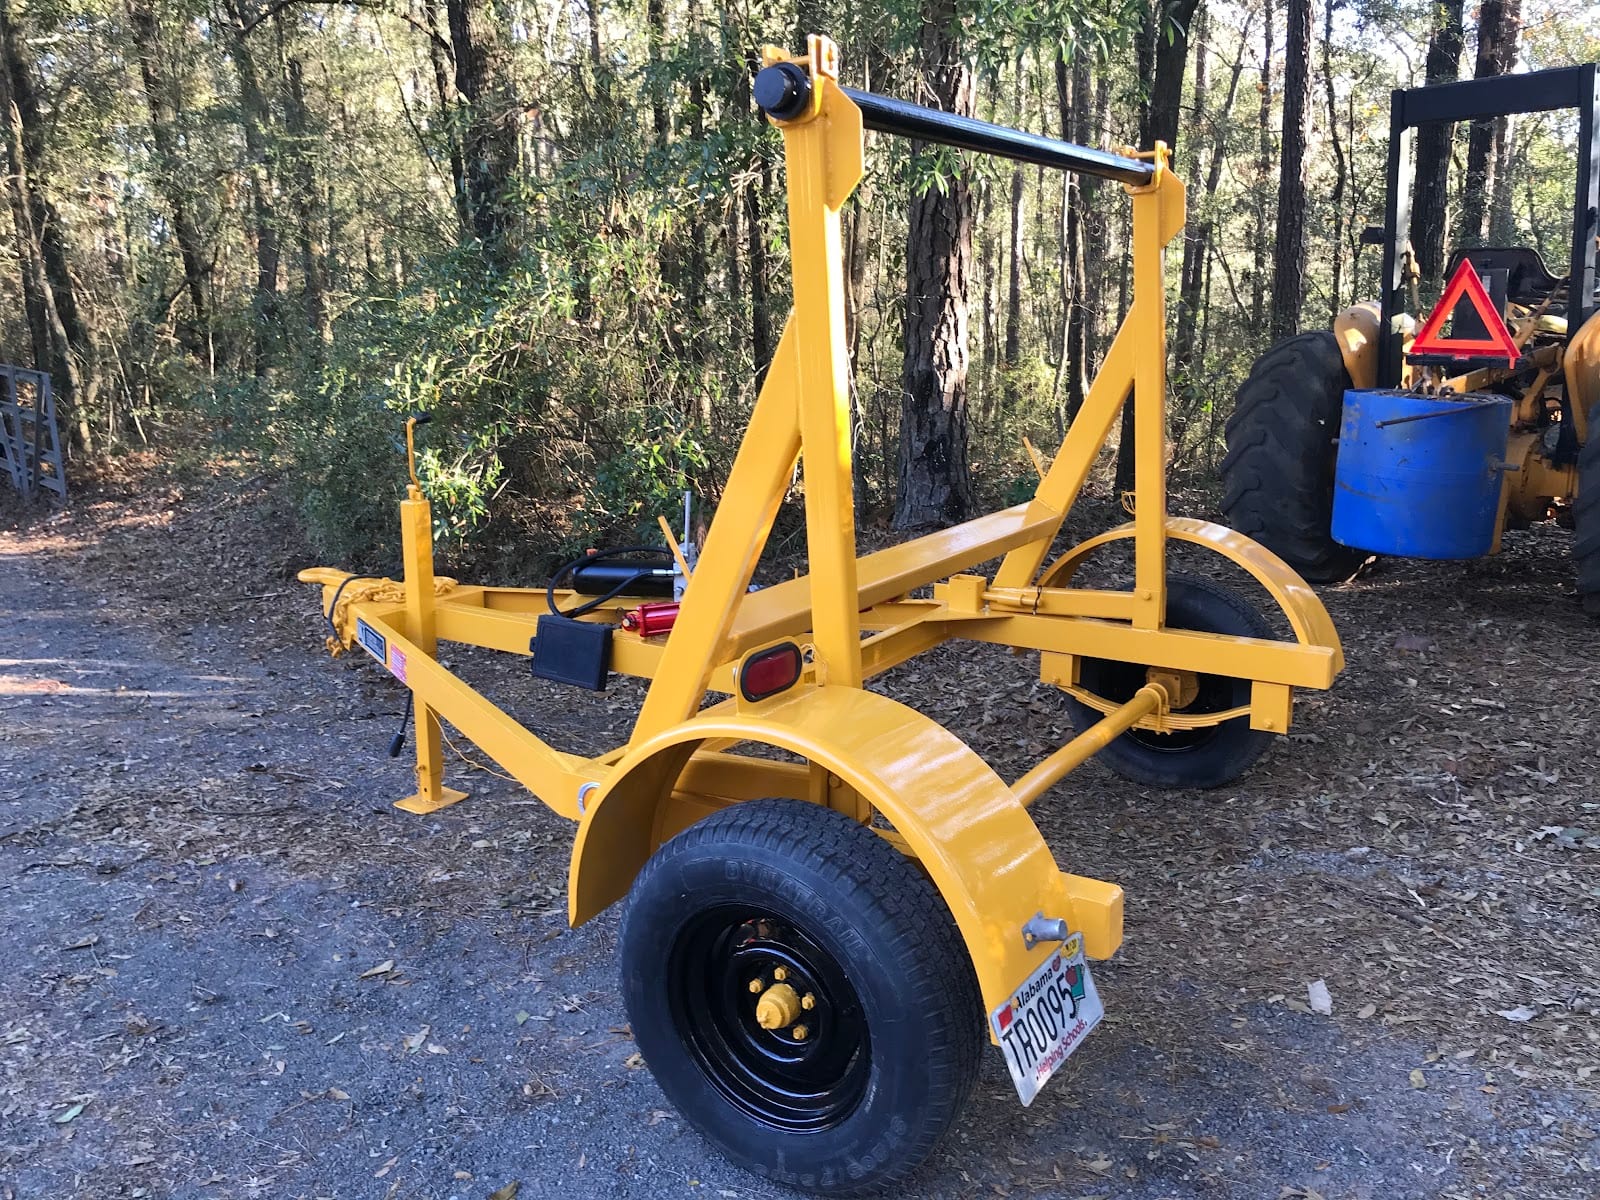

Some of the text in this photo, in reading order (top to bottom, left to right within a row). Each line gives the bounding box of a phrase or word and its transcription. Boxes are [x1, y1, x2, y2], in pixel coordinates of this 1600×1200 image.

[725, 859, 864, 960] DYNATRAIL
[1001, 972, 1077, 1077] TR0095
[1036, 1018, 1085, 1076] Helping Schools
